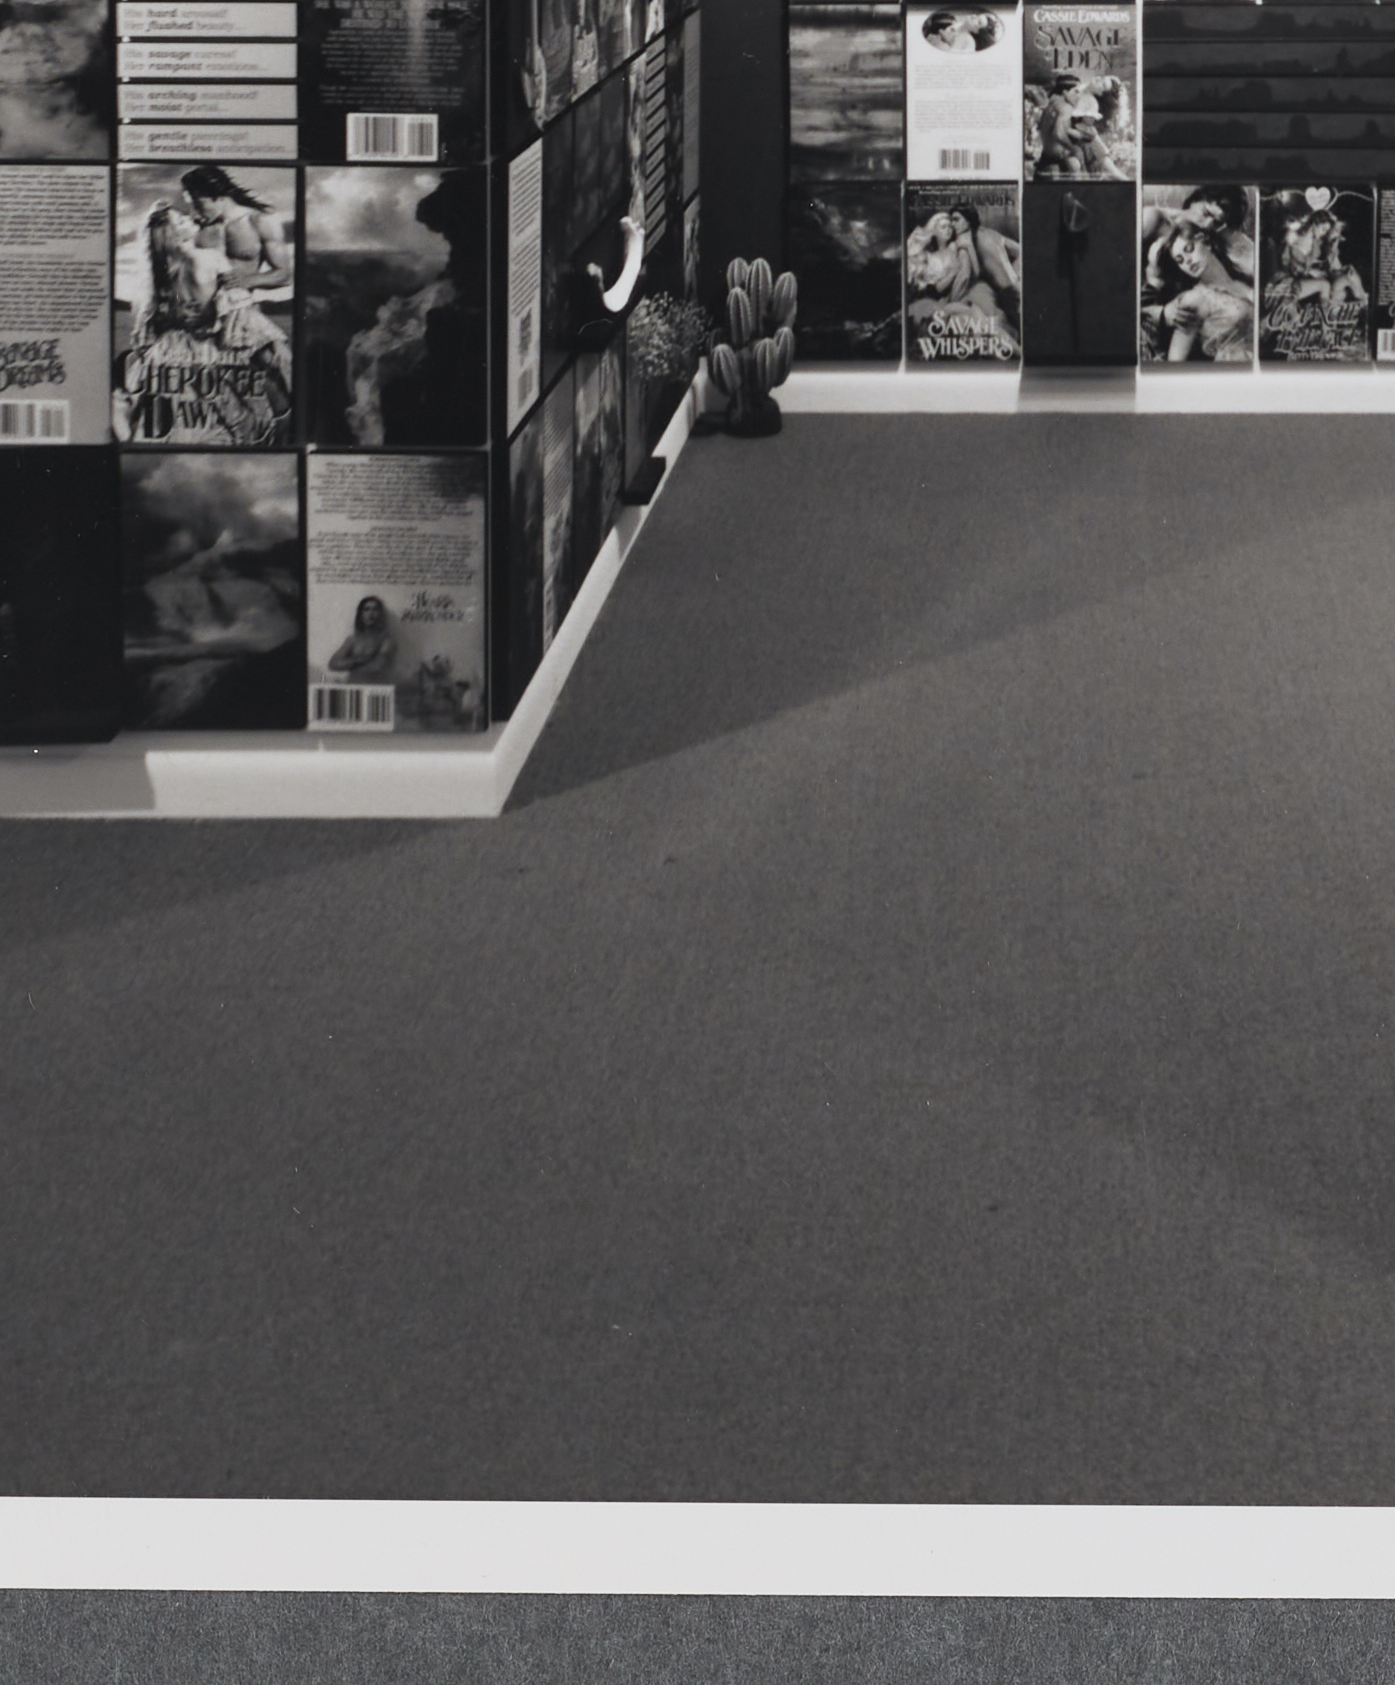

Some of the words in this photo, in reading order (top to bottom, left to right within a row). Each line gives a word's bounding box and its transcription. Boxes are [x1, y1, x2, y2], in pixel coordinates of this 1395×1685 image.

[147, 8, 179, 17] hard
[1034, 9, 1077, 23] CASSIE
[1078, 9, 1131, 23] EDWARDS
[145, 20, 194, 32] flushed
[1034, 25, 1125, 49] SAVAGE
[147, 50, 192, 60] savage
[1044, 47, 1114, 73] EDEN
[148, 62, 203, 72] rampant
[148, 103, 183, 111] moist
[148, 131, 188, 142] gentle
[148, 143, 213, 153] breathless
[928, 310, 995, 337] SAVAGE
[918, 334, 1014, 361] WHISPERS
[112, 348, 268, 400] CHEROKEE
